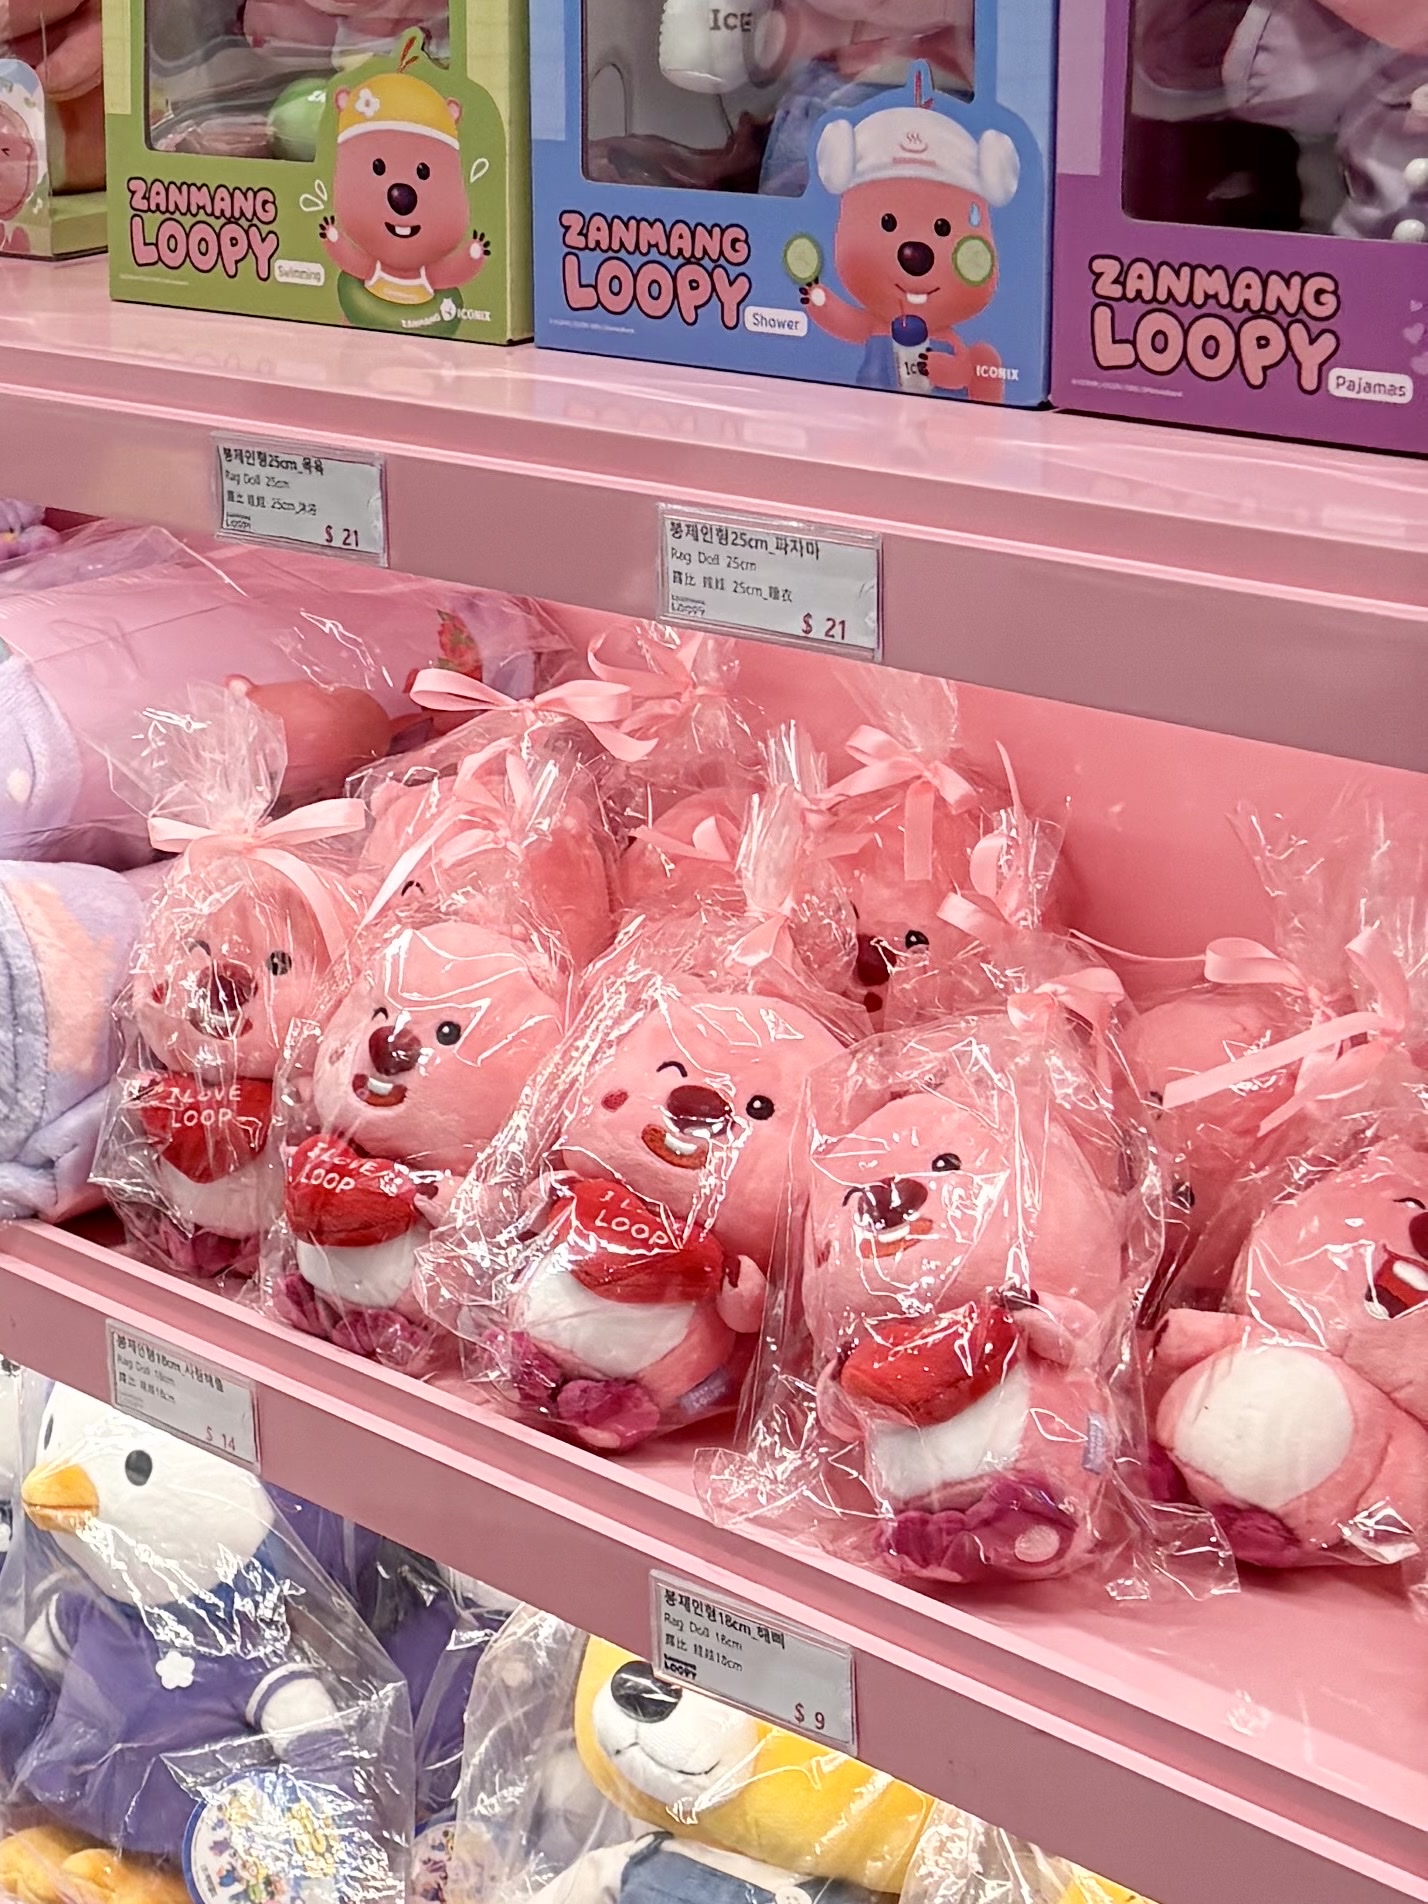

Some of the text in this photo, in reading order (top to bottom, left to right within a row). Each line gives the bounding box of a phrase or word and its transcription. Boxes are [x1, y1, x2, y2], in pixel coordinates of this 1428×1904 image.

[127, 176, 278, 225] ZANMANG
[130, 214, 280, 282] LOOPY
[559, 209, 751, 267] ZANMANG
[562, 252, 752, 331] LOOPY
[1088, 254, 1341, 322] ZANMANG
[752, 312, 800, 332] Shower
[1090, 301, 1341, 396] LOOPY
[975, 364, 1020, 382] ICONIX
[1335, 375, 1407, 398] Pajamas
[325, 525, 359, 547] $ 21
[726, 556, 757, 572] 25cm
[801, 612, 846, 641] $ 21
[222, 1434, 236, 1451] 14
[715, 1632, 743, 1650] 18cm
[795, 1703, 825, 1730] $ 9
